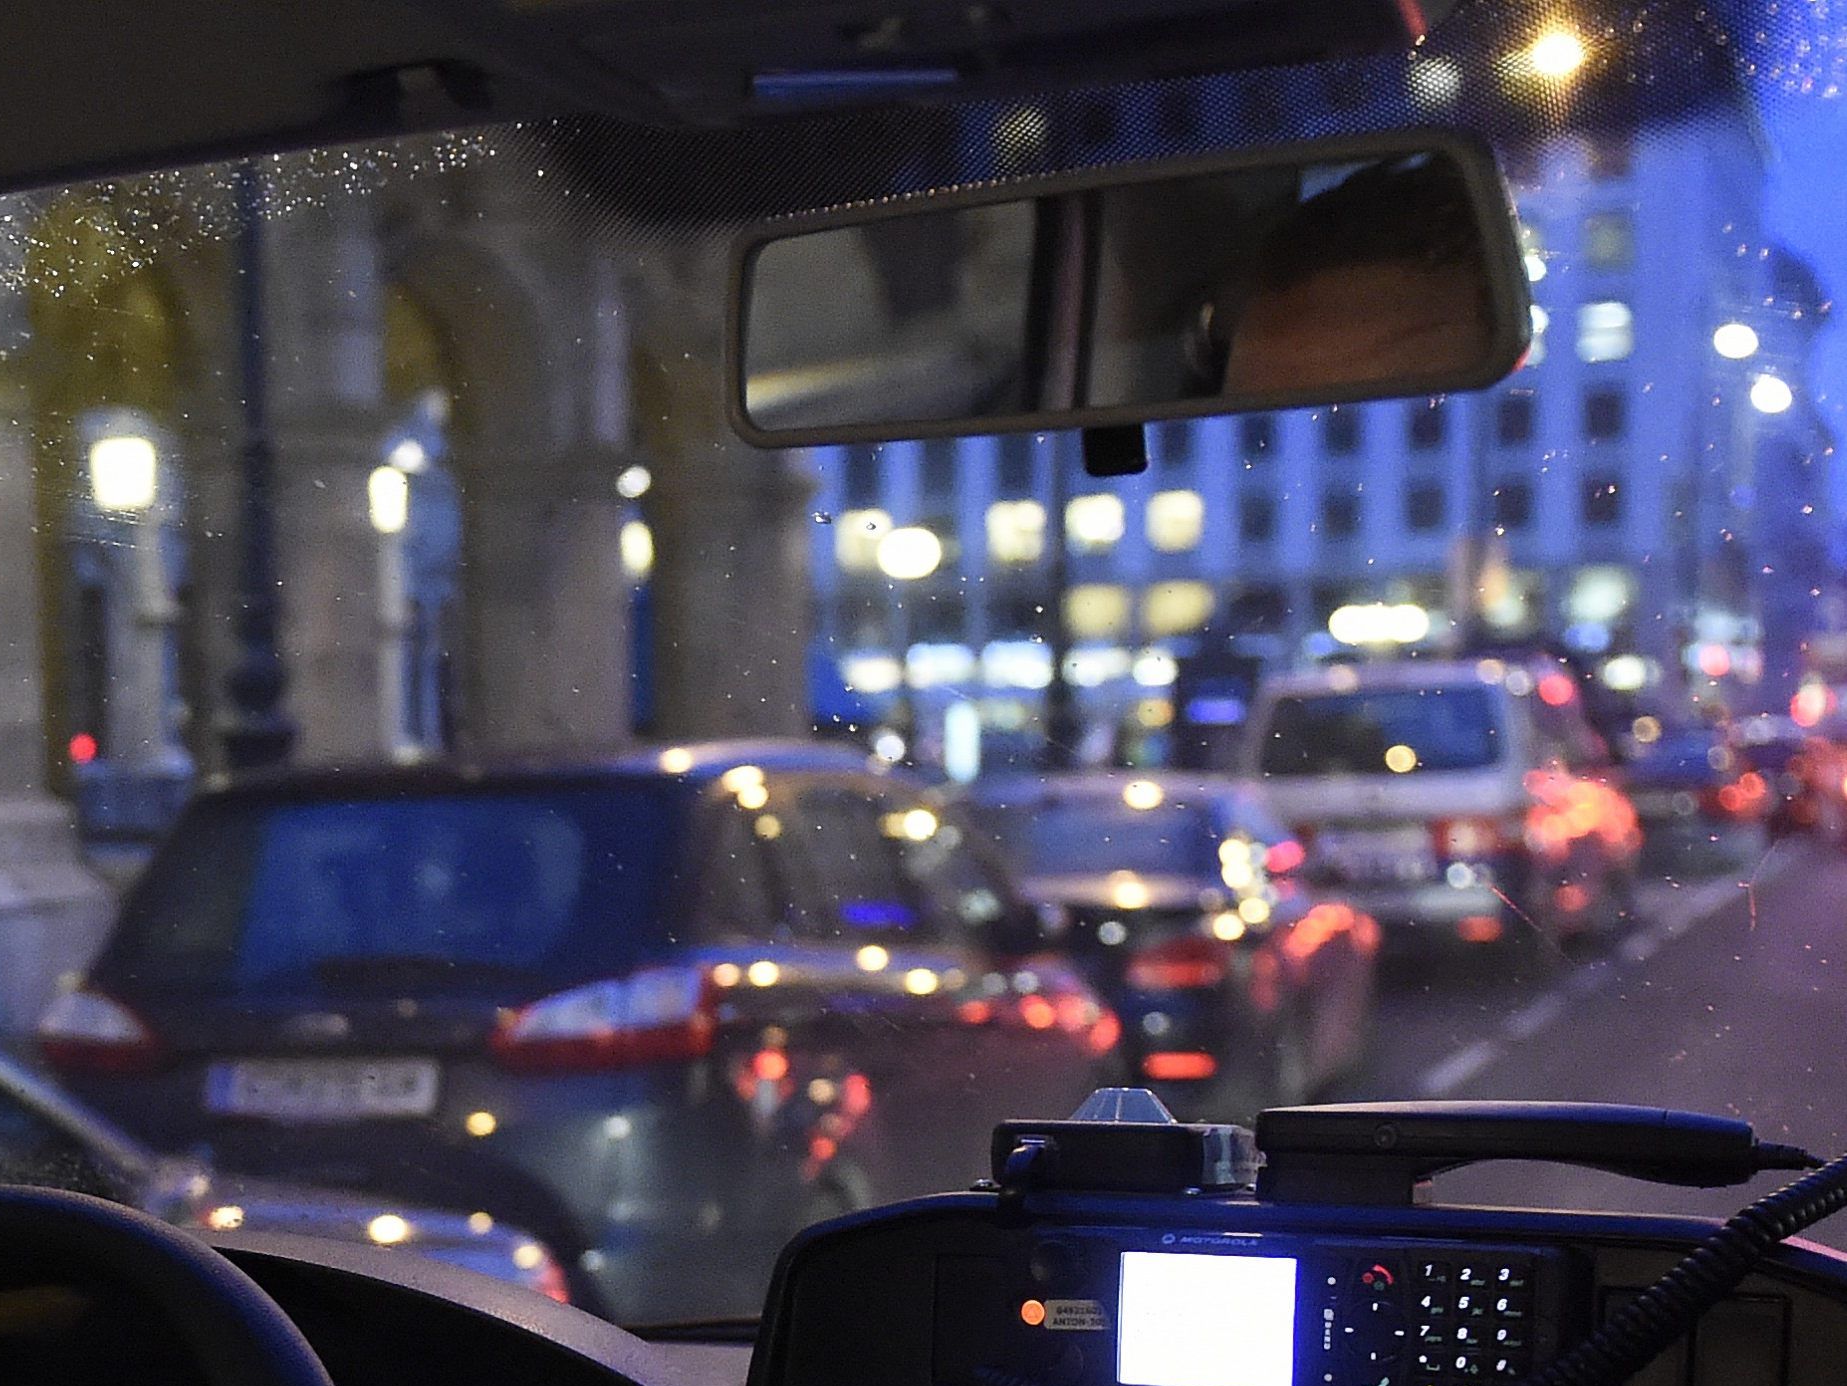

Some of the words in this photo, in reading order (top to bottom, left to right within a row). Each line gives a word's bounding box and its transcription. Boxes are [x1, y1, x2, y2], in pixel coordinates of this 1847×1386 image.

[1180, 1236, 1258, 1247] MOTOROLA
[1425, 1264, 1433, 1277] 1
[1460, 1268, 1472, 1281] 2
[1498, 1268, 1510, 1281] 3
[1421, 1295, 1432, 1308] 4
[1458, 1296, 1470, 1309] 5
[1496, 1298, 1508, 1311] 6
[1419, 1325, 1431, 1337] 7
[1456, 1327, 1468, 1340] 8
[1496, 1329, 1507, 1341] 9
